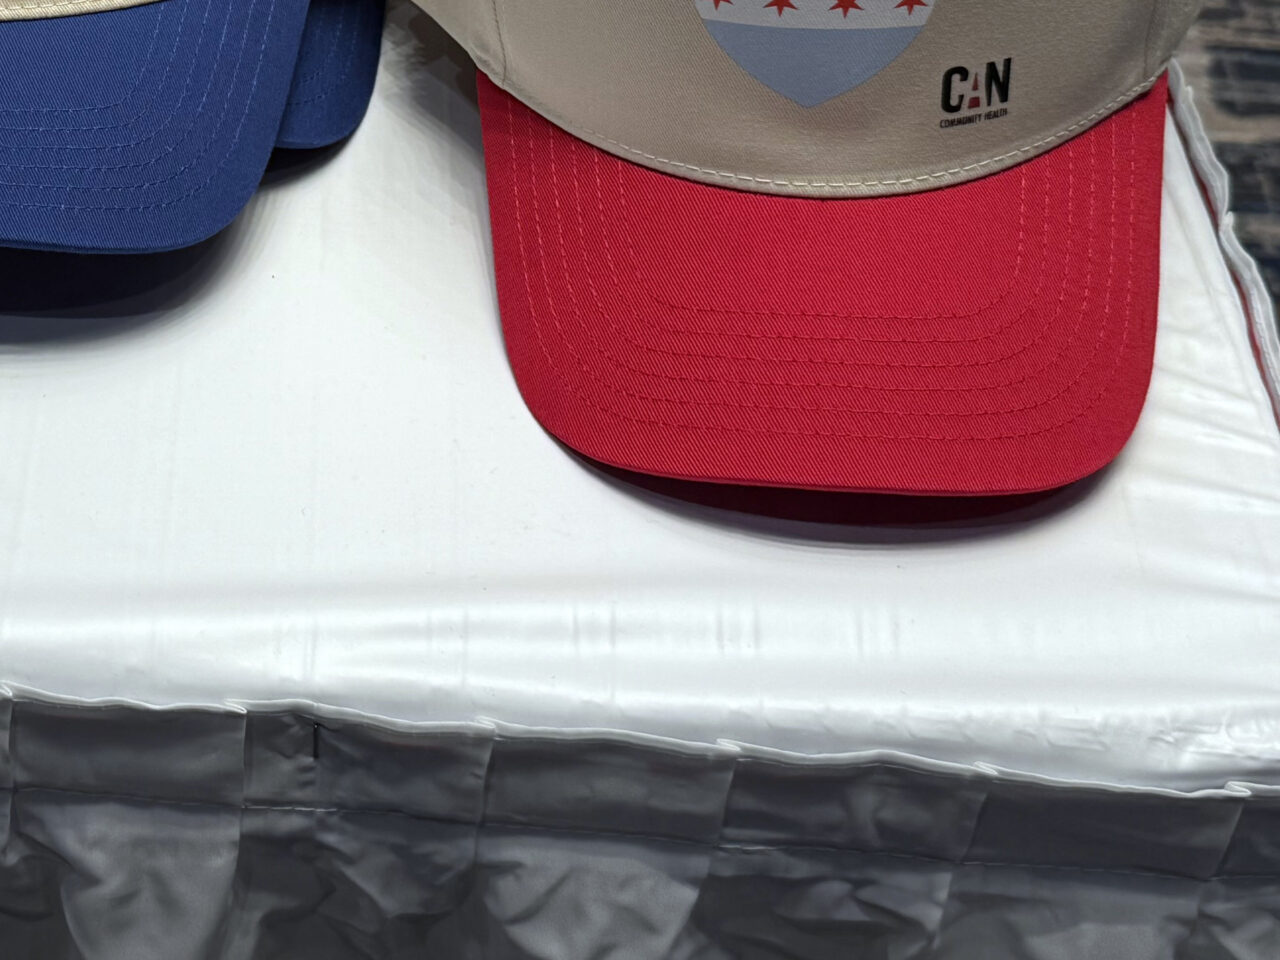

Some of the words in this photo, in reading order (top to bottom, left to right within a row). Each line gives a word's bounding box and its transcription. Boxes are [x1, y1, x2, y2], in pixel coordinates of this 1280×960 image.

[941, 57, 1012, 113] CAN
[940, 113, 982, 129] COMMUNITY
[984, 108, 1008, 121] HEALTH
